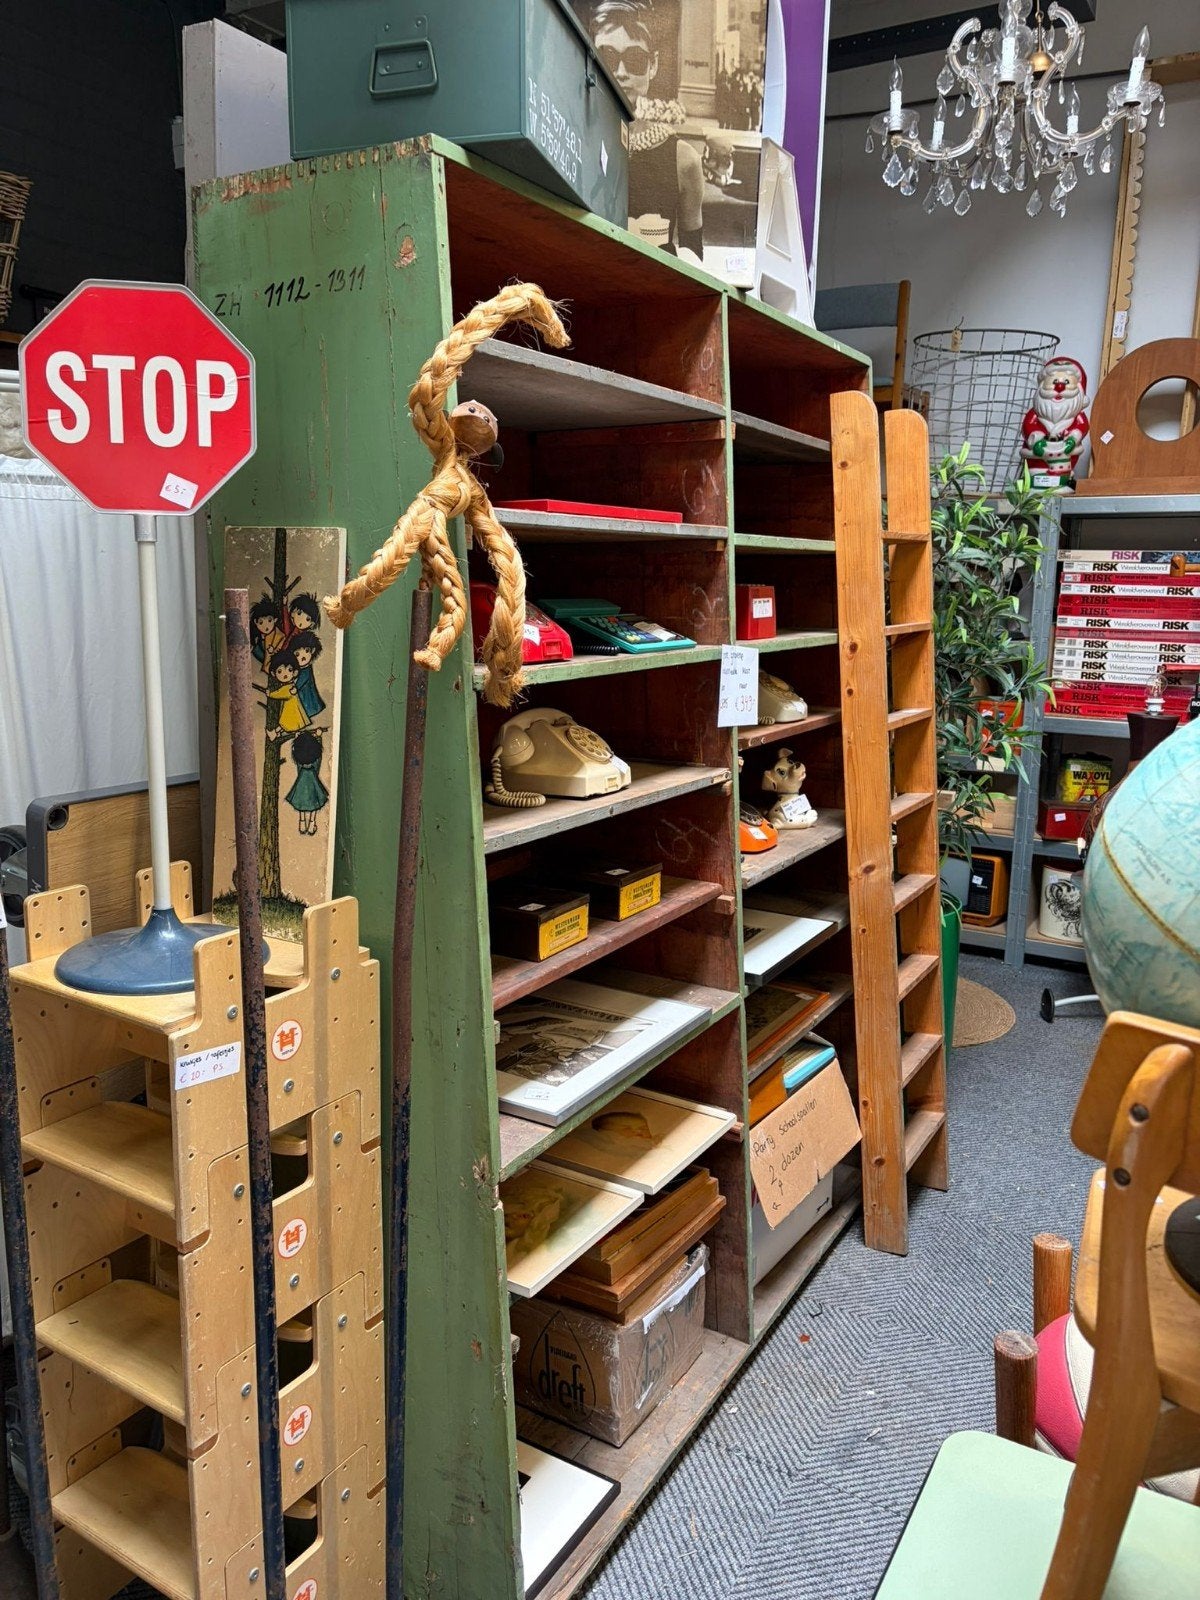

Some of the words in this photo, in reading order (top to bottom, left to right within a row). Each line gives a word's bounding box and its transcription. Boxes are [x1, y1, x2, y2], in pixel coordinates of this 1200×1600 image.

[46, 350, 239, 448] STOP
[1111, 551, 1140, 560] RISK
[1092, 562, 1119, 571] RISK
[1083, 574, 1112, 583] RISK
[1089, 585, 1116, 594] RISK
[1166, 587, 1194, 596] RISK
[1081, 596, 1110, 605] RISK
[1080, 607, 1110, 616] RISK
[1086, 619, 1112, 628] RISK
[1162, 621, 1190, 630] RISK
[1083, 640, 1108, 649] RISK
[1159, 643, 1187, 652] RISK
[1083, 651, 1108, 659] RISK
[1158, 654, 1186, 663] RISK
[1081, 661, 1107, 670] RISK
[1080, 671, 1106, 680] RISK
[1072, 692, 1099, 701] RISK
[1073, 770, 1110, 780] WAXOYL
[781, 1142, 805, 1171] dozen
[538, 1334, 586, 1415] dreft
